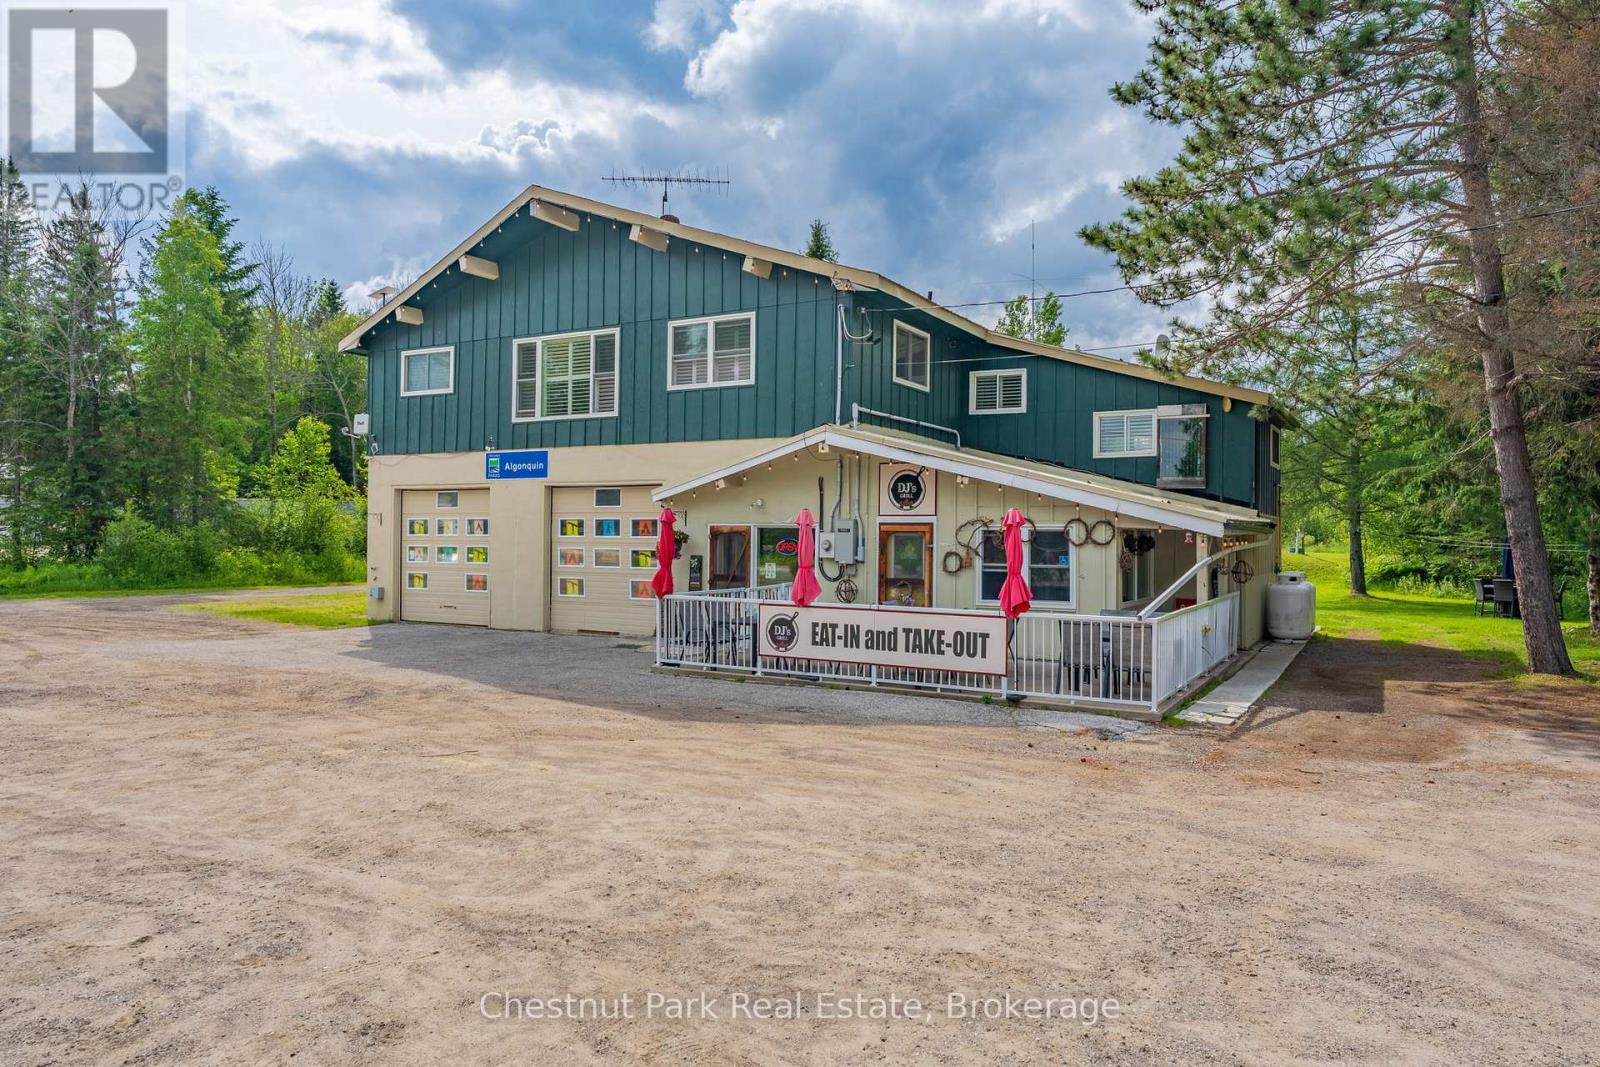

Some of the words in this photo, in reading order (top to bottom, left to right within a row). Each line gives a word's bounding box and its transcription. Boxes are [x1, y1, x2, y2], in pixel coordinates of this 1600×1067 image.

[504, 461, 544, 472] Algonquin
[897, 482, 917, 493] DJ's
[774, 625, 791, 636] DJ's
[811, 621, 861, 649] EAT-IN
[864, 626, 898, 652] and
[902, 627, 991, 659] TAKE-OUT
